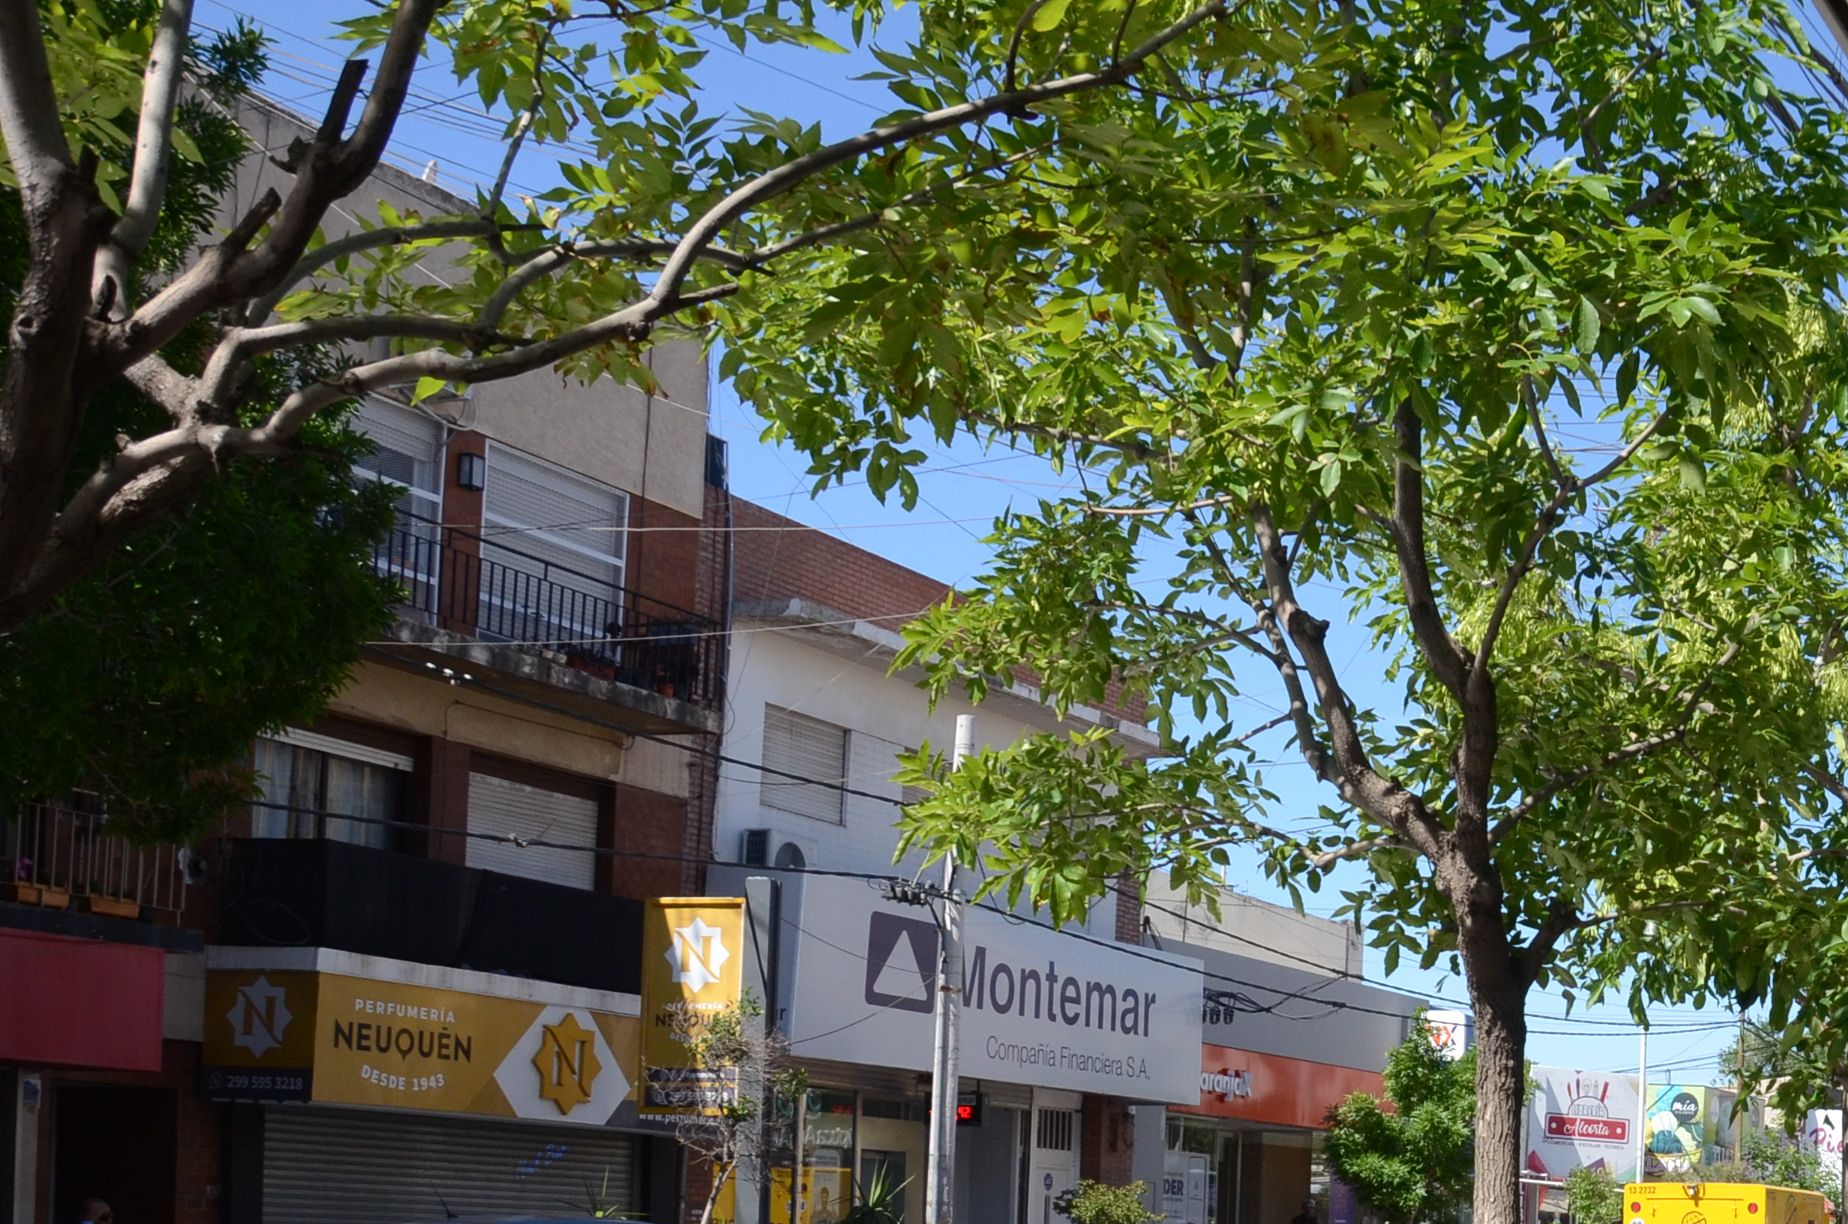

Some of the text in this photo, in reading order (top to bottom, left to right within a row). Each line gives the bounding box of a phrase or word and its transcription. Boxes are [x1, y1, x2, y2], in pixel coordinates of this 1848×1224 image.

[961, 945, 1156, 1038] Montemar
[354, 998, 455, 1023] PERFUMERÍA
[333, 1018, 472, 1063] NEUQUÉN
[986, 1035, 1150, 1080] Compañía Financiera S.A.
[274, 1077, 303, 1091] 3218
[361, 1063, 445, 1092] DESDE 1943
